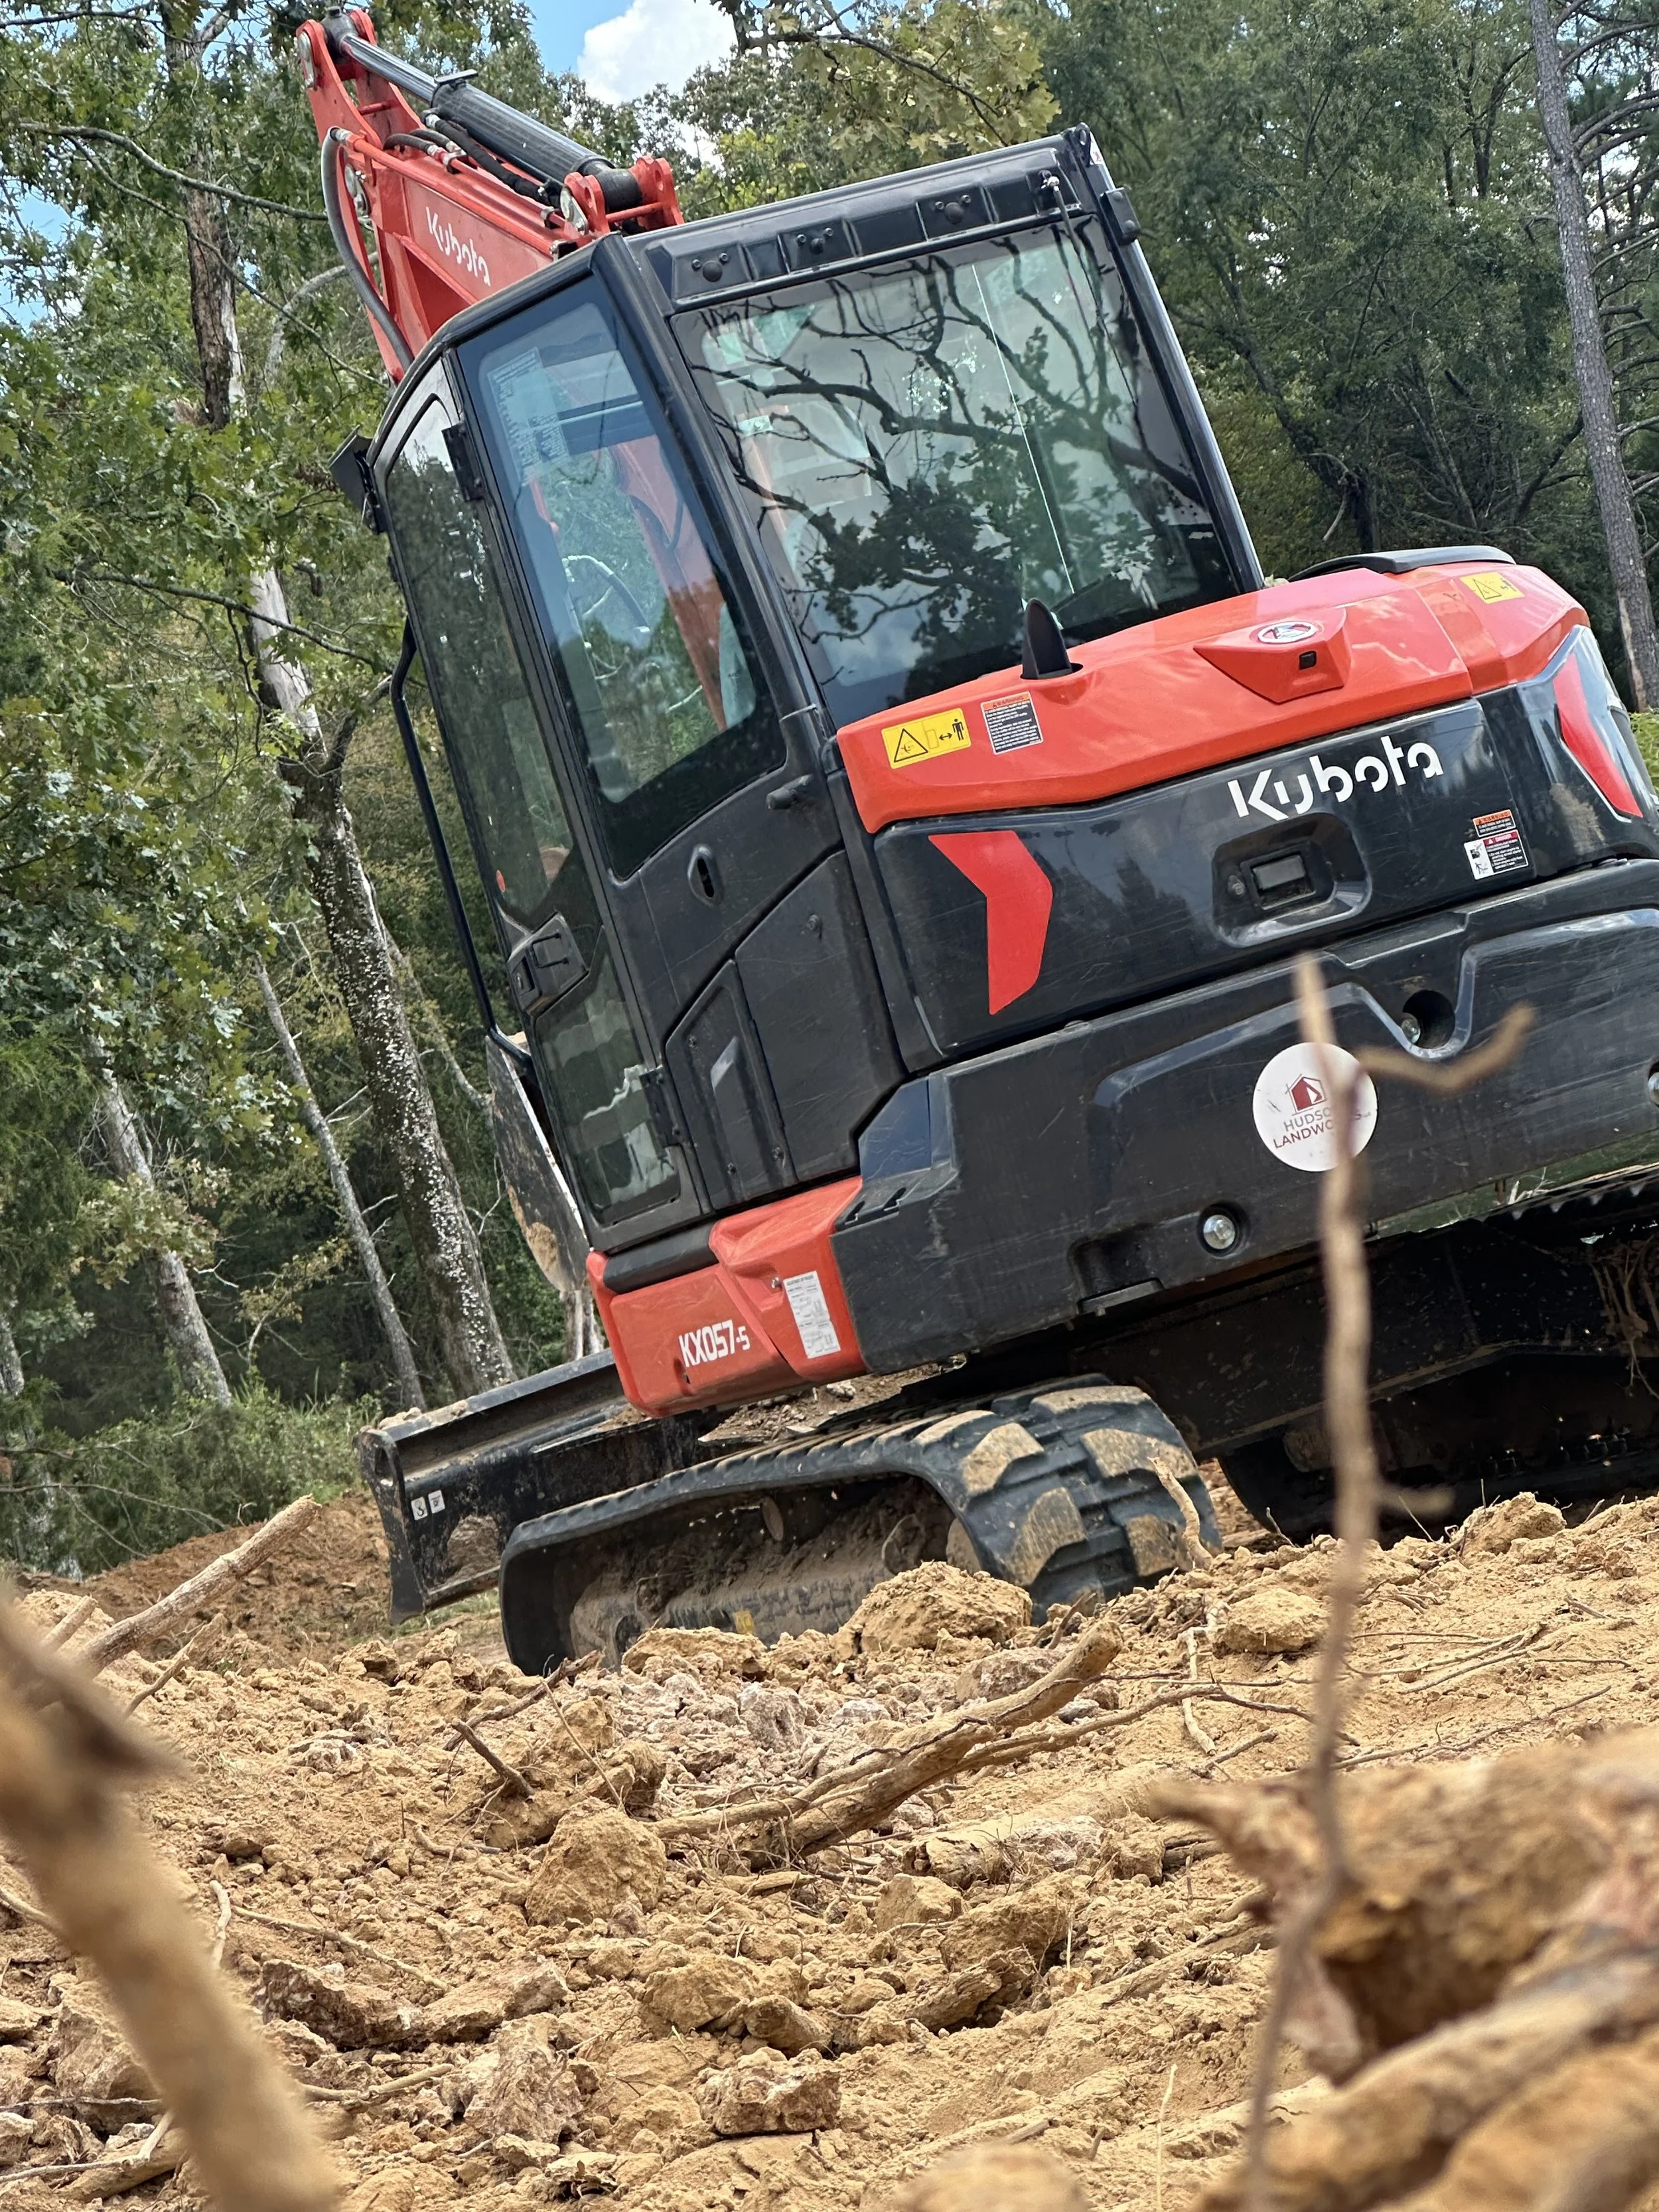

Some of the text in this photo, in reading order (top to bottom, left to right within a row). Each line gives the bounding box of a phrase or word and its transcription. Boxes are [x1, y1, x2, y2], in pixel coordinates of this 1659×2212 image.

[426, 206, 490, 287] Kubota
[1228, 735, 1443, 821] Kubota
[1284, 1107, 1332, 1132] HUDSO
[678, 1319, 751, 1367] KX057-5
